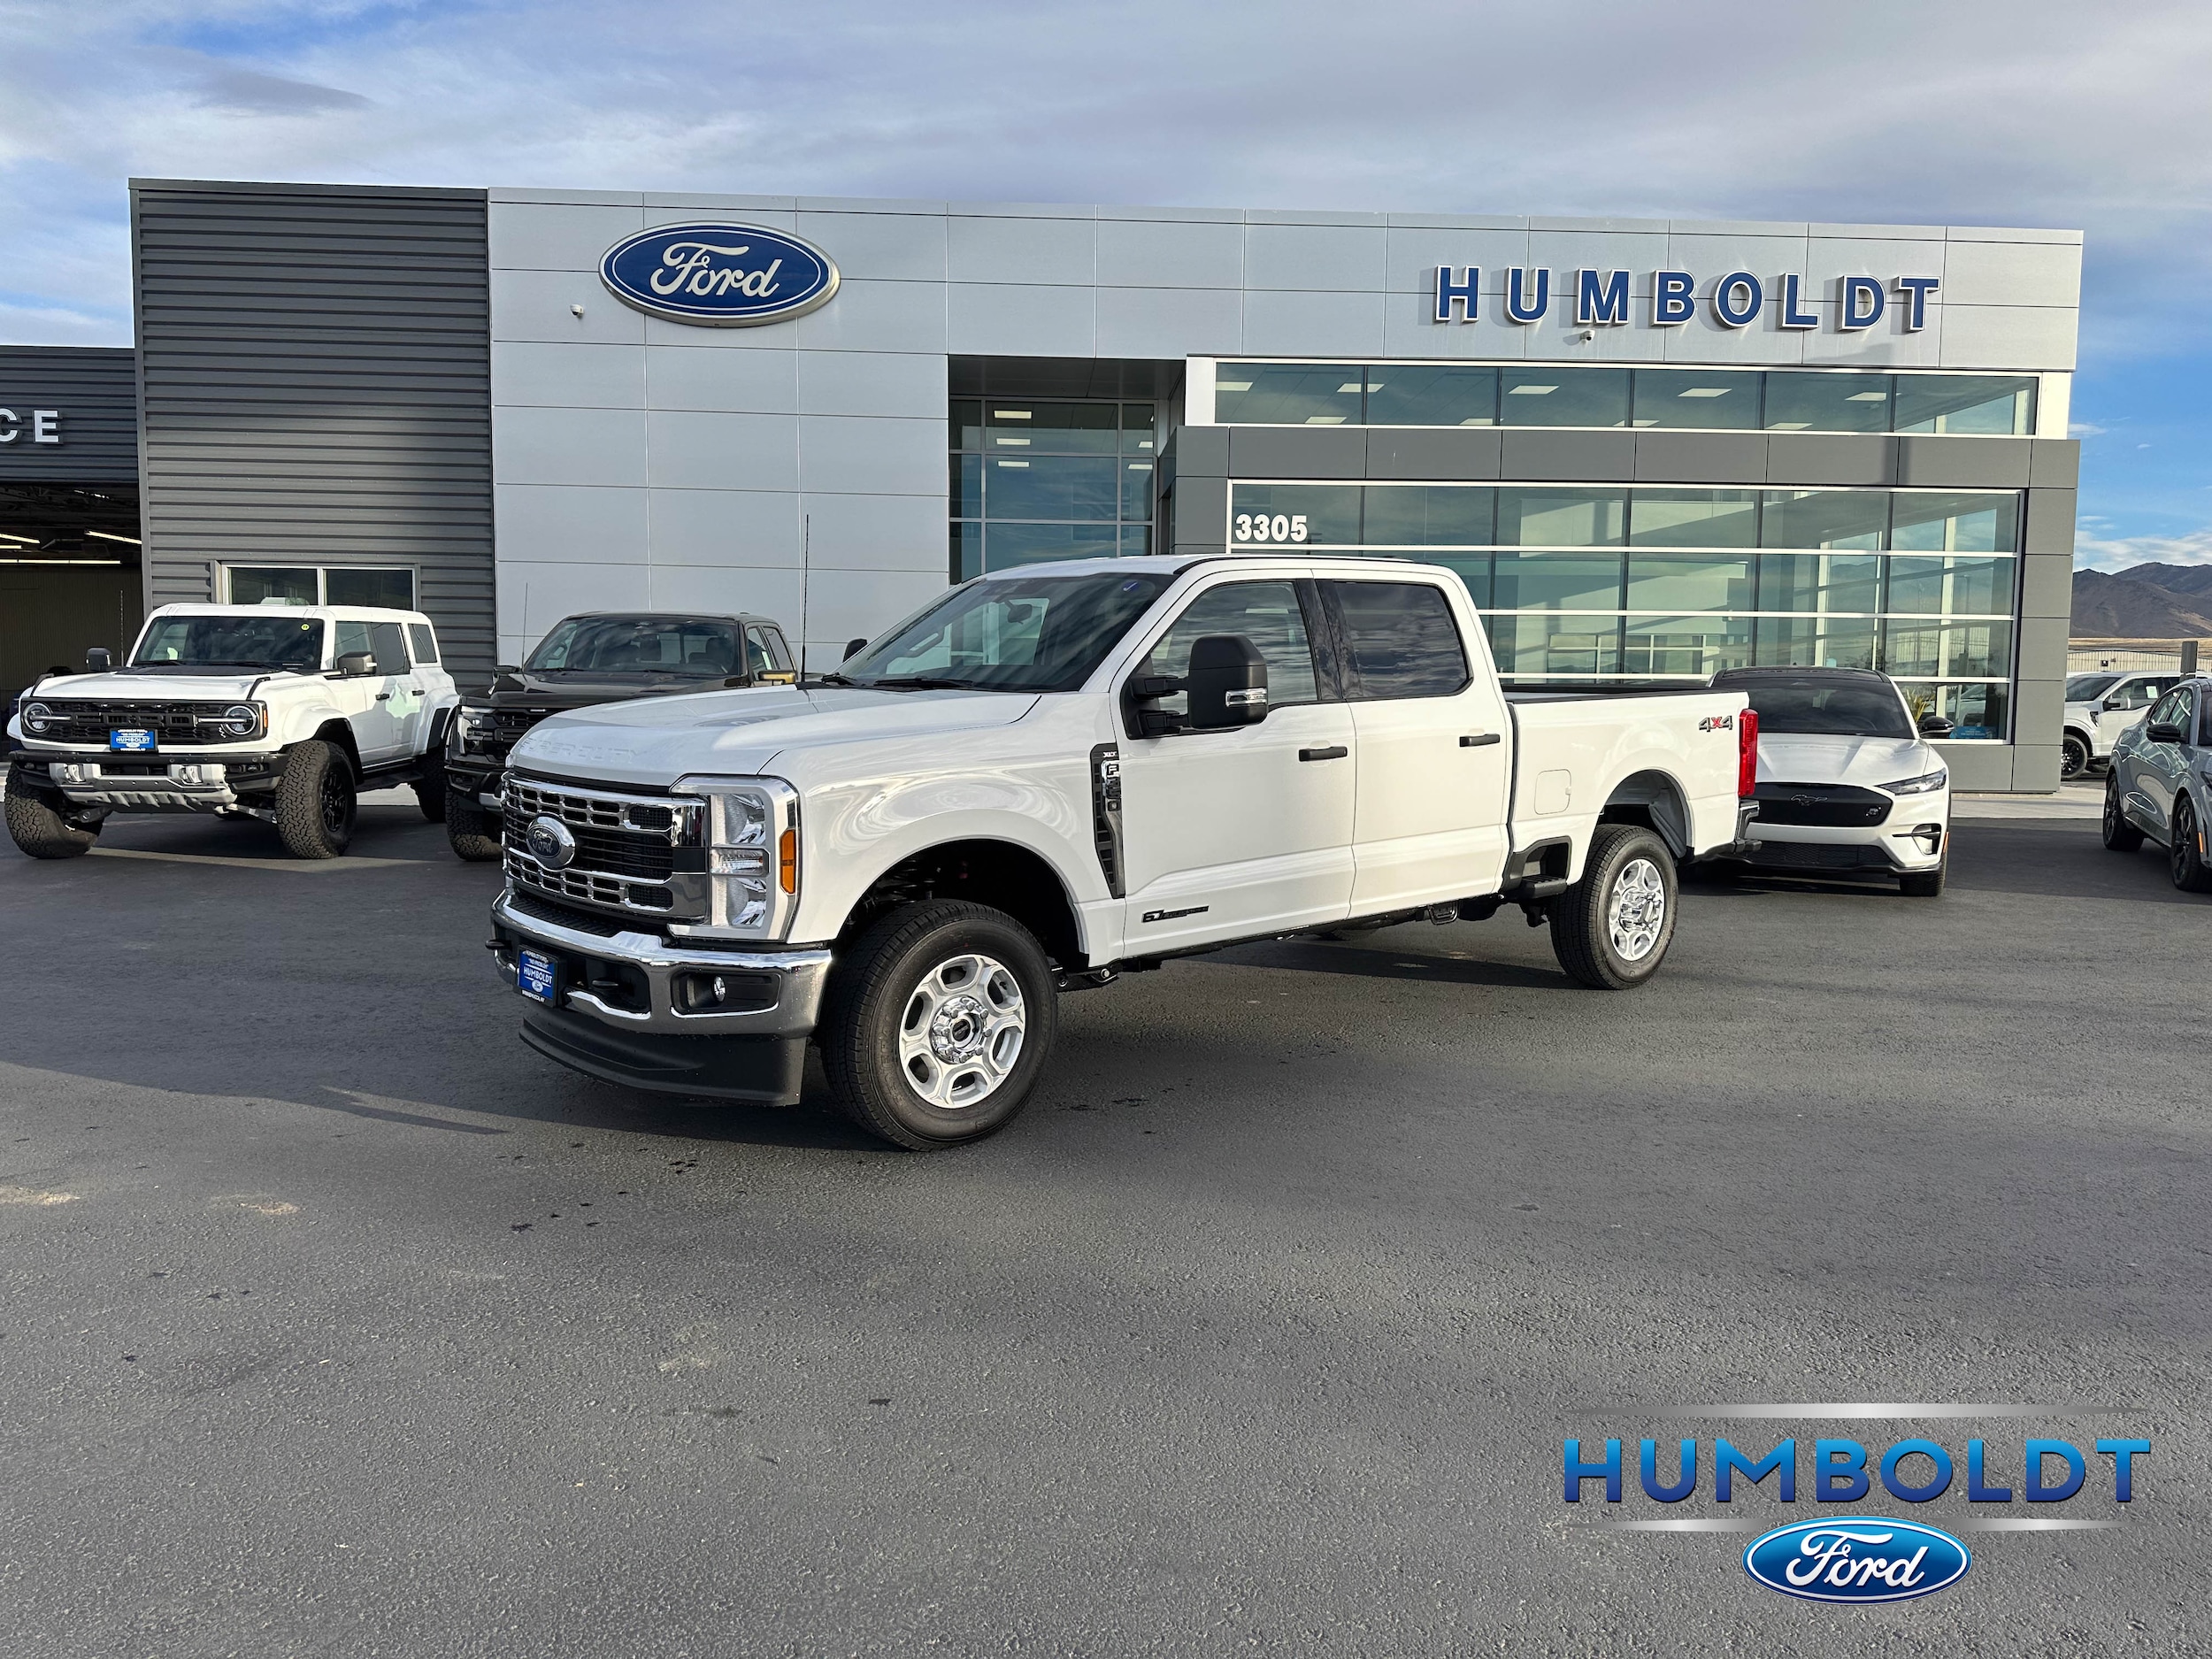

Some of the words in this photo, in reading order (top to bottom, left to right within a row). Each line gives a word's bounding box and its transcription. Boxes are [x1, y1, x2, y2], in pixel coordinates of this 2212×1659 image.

[649, 242, 784, 298] Ford
[1434, 265, 1940, 332] HUMBOLDT
[1235, 513, 1308, 541] 3305
[523, 965, 552, 984] HUMBOLDT
